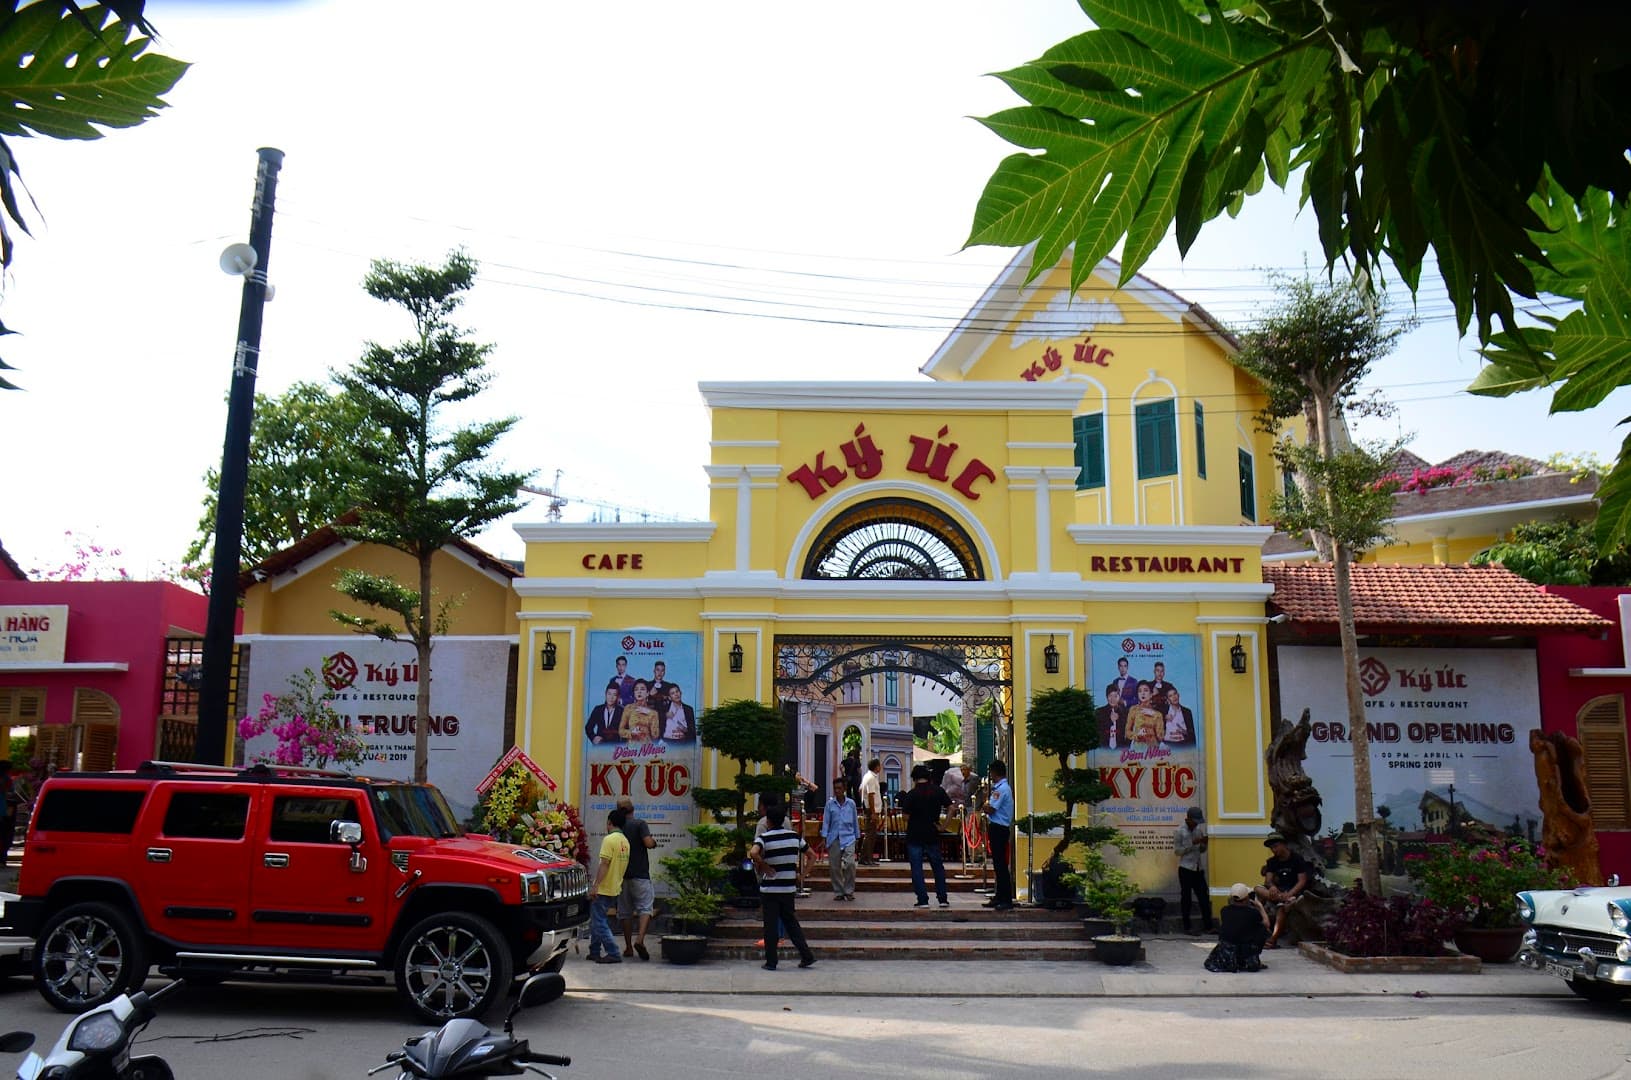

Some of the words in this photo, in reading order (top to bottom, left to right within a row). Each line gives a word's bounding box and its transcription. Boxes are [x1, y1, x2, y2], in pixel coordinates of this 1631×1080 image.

[582, 554, 643, 570] CAFE
[1091, 556, 1245, 573] RESTAURANT
[364, 662, 401, 687] Ký
[1395, 667, 1433, 693] Ký
[1364, 701, 1385, 709] AFE
[1400, 701, 1468, 709] RESTAURANT
[1312, 722, 1401, 744] GRND
[1407, 722, 1515, 744] OPENING
[389, 753, 408, 761] 2019
[1388, 760, 1421, 769] SPRING
[1423, 760, 1443, 769] 2019
